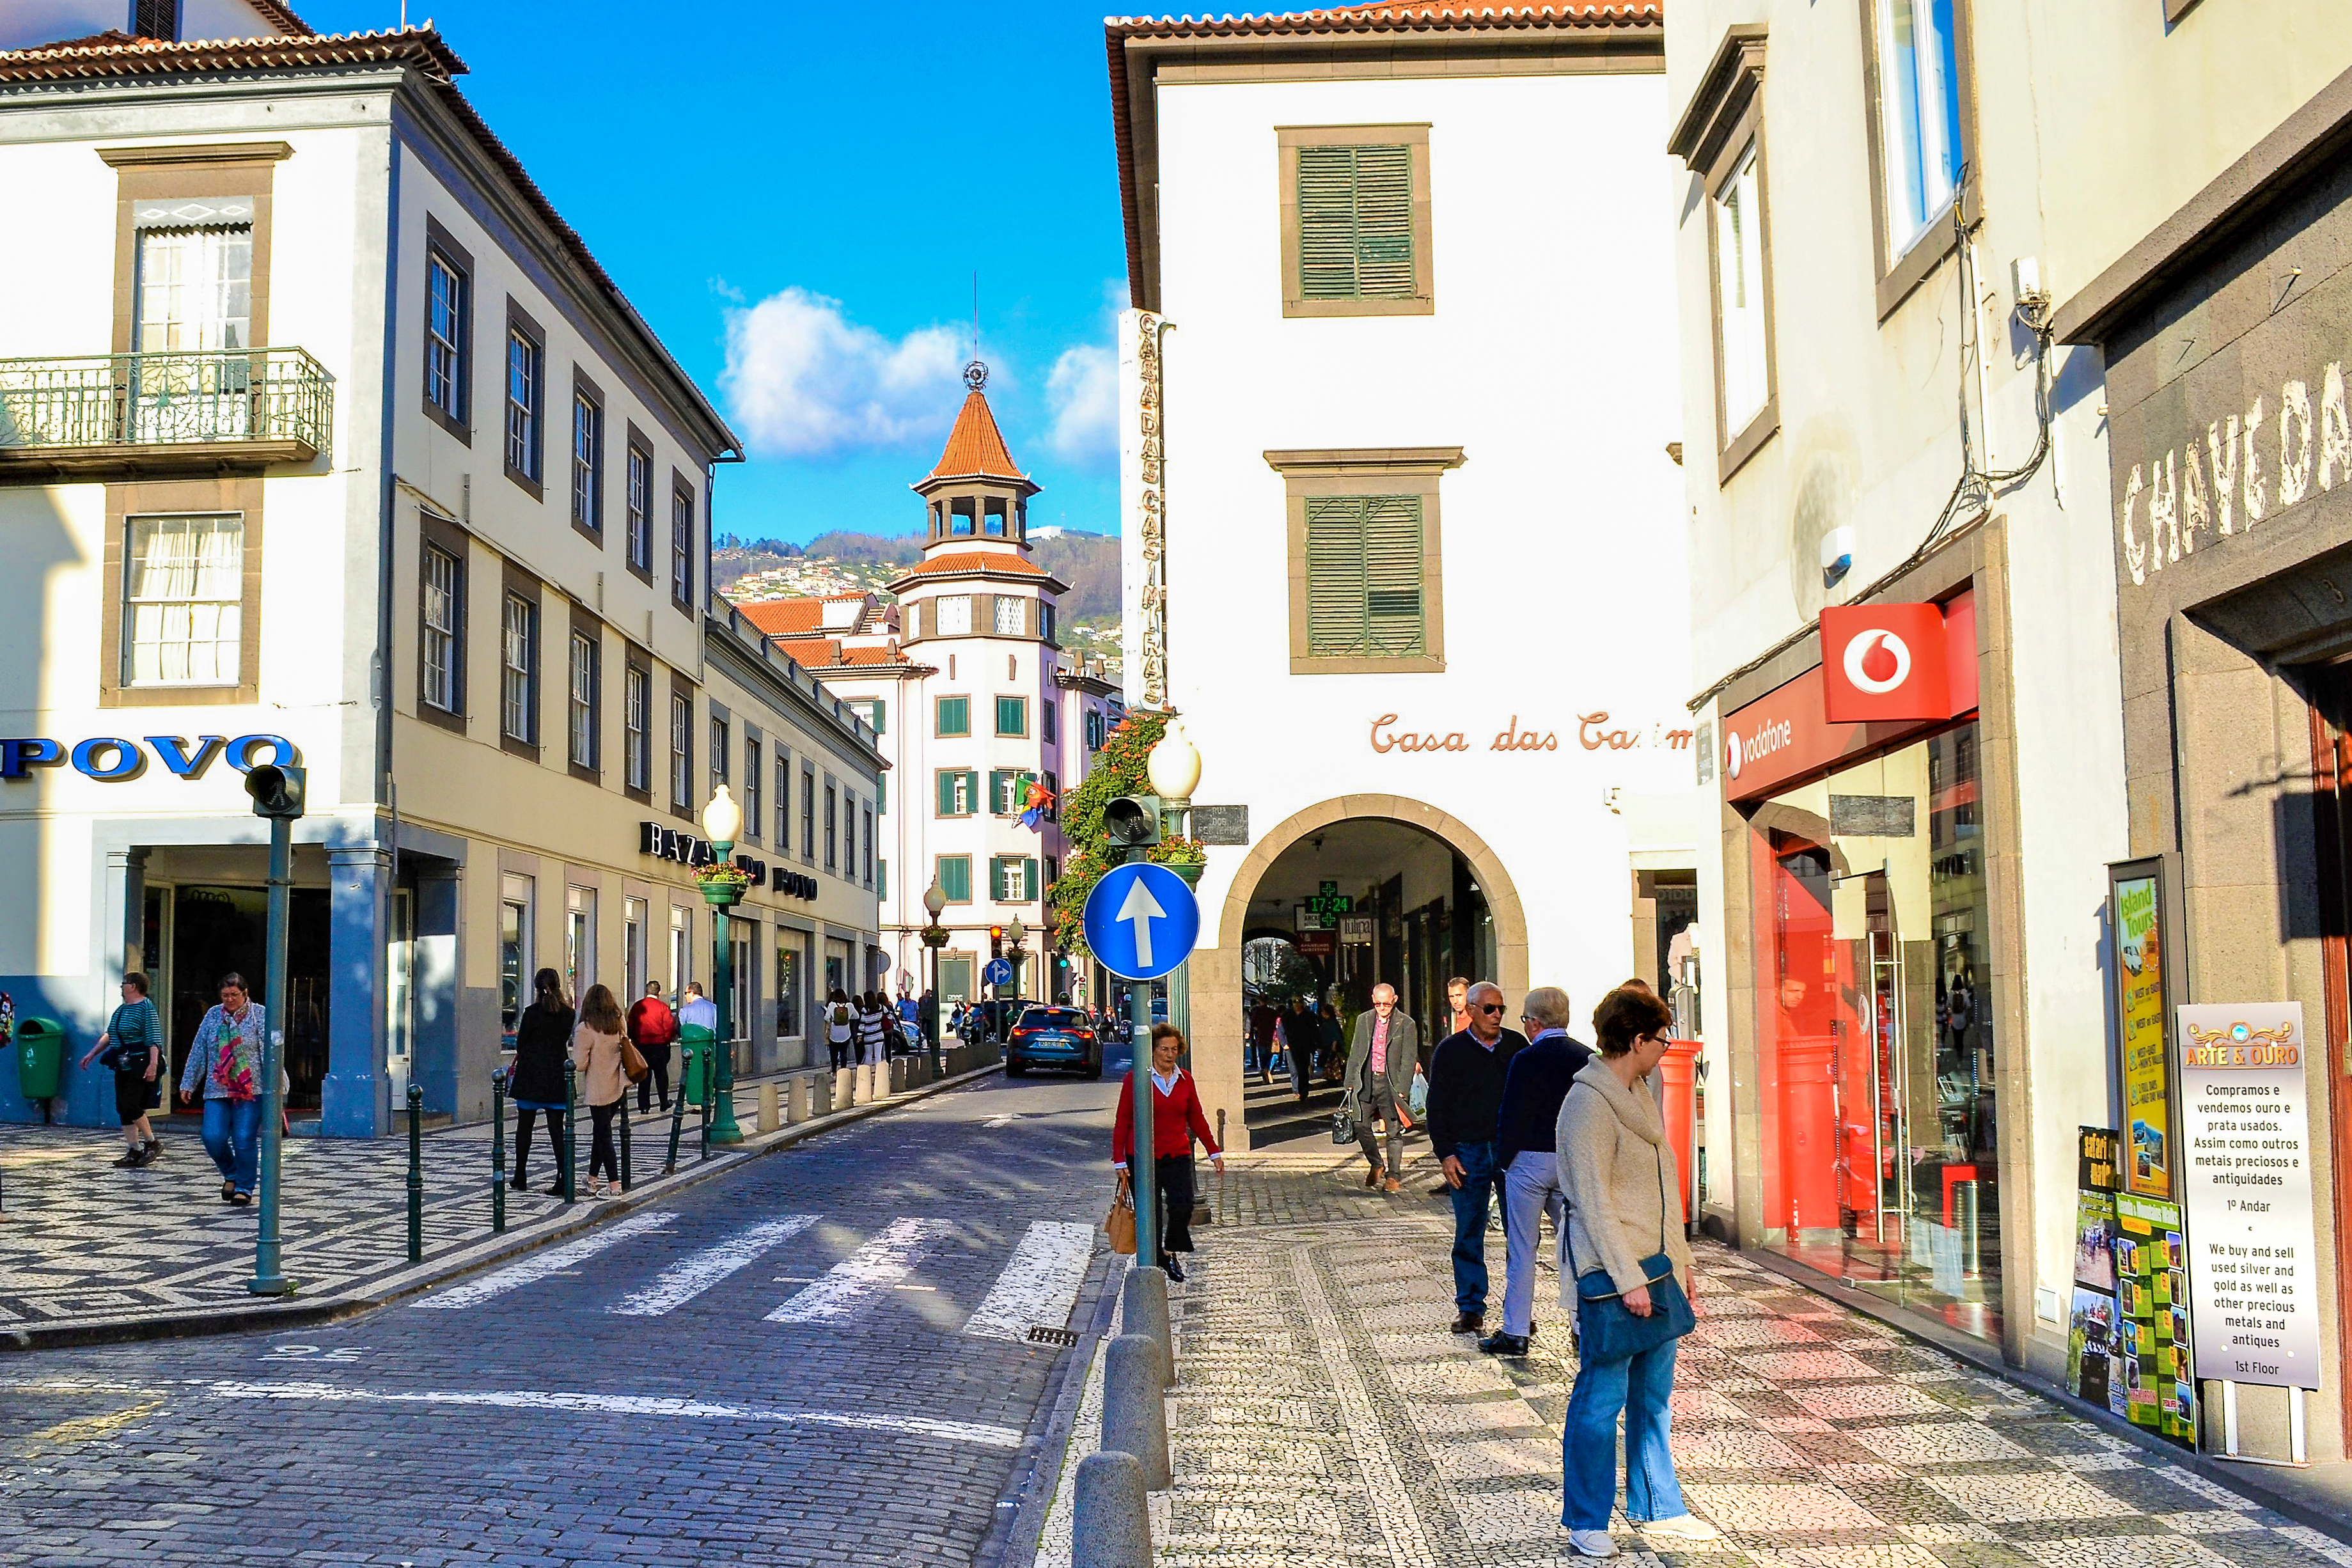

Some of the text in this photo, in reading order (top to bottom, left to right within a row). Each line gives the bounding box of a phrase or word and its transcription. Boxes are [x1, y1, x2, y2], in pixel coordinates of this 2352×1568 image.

[1368, 714, 1469, 753] Casa
[1489, 714, 1558, 751] das
[1742, 718, 1791, 765] vodafone
[0, 733, 297, 778] POVO
[1310, 897, 1348, 912] 17:24
[2120, 879, 2152, 917] Island
[2126, 912, 2154, 939] Tours
[2186, 1046, 2298, 1066] ARTE & OURO
[2206, 1085, 2280, 1097] Compramos e
[2197, 1102, 2291, 1113] vendemos ouro e
[2208, 1120, 2282, 1133] prata usados.
[2194, 1138, 2298, 1149] Assim como outros
[2196, 1155, 2299, 1168] metais preciosos e
[2213, 1173, 2283, 1187] antiguidades
[2240, 1200, 2271, 1212] Andar
[2209, 1244, 2294, 1258] We buy and sell
[2211, 1262, 2294, 1276] used silver and
[2214, 1280, 2293, 1294] gold as well as
[2214, 1298, 2294, 1312] other precious
[2225, 1316, 2285, 1330] metals and
[2232, 1334, 2280, 1348] antiques
[2236, 1361, 2279, 1375] 1st Floor
